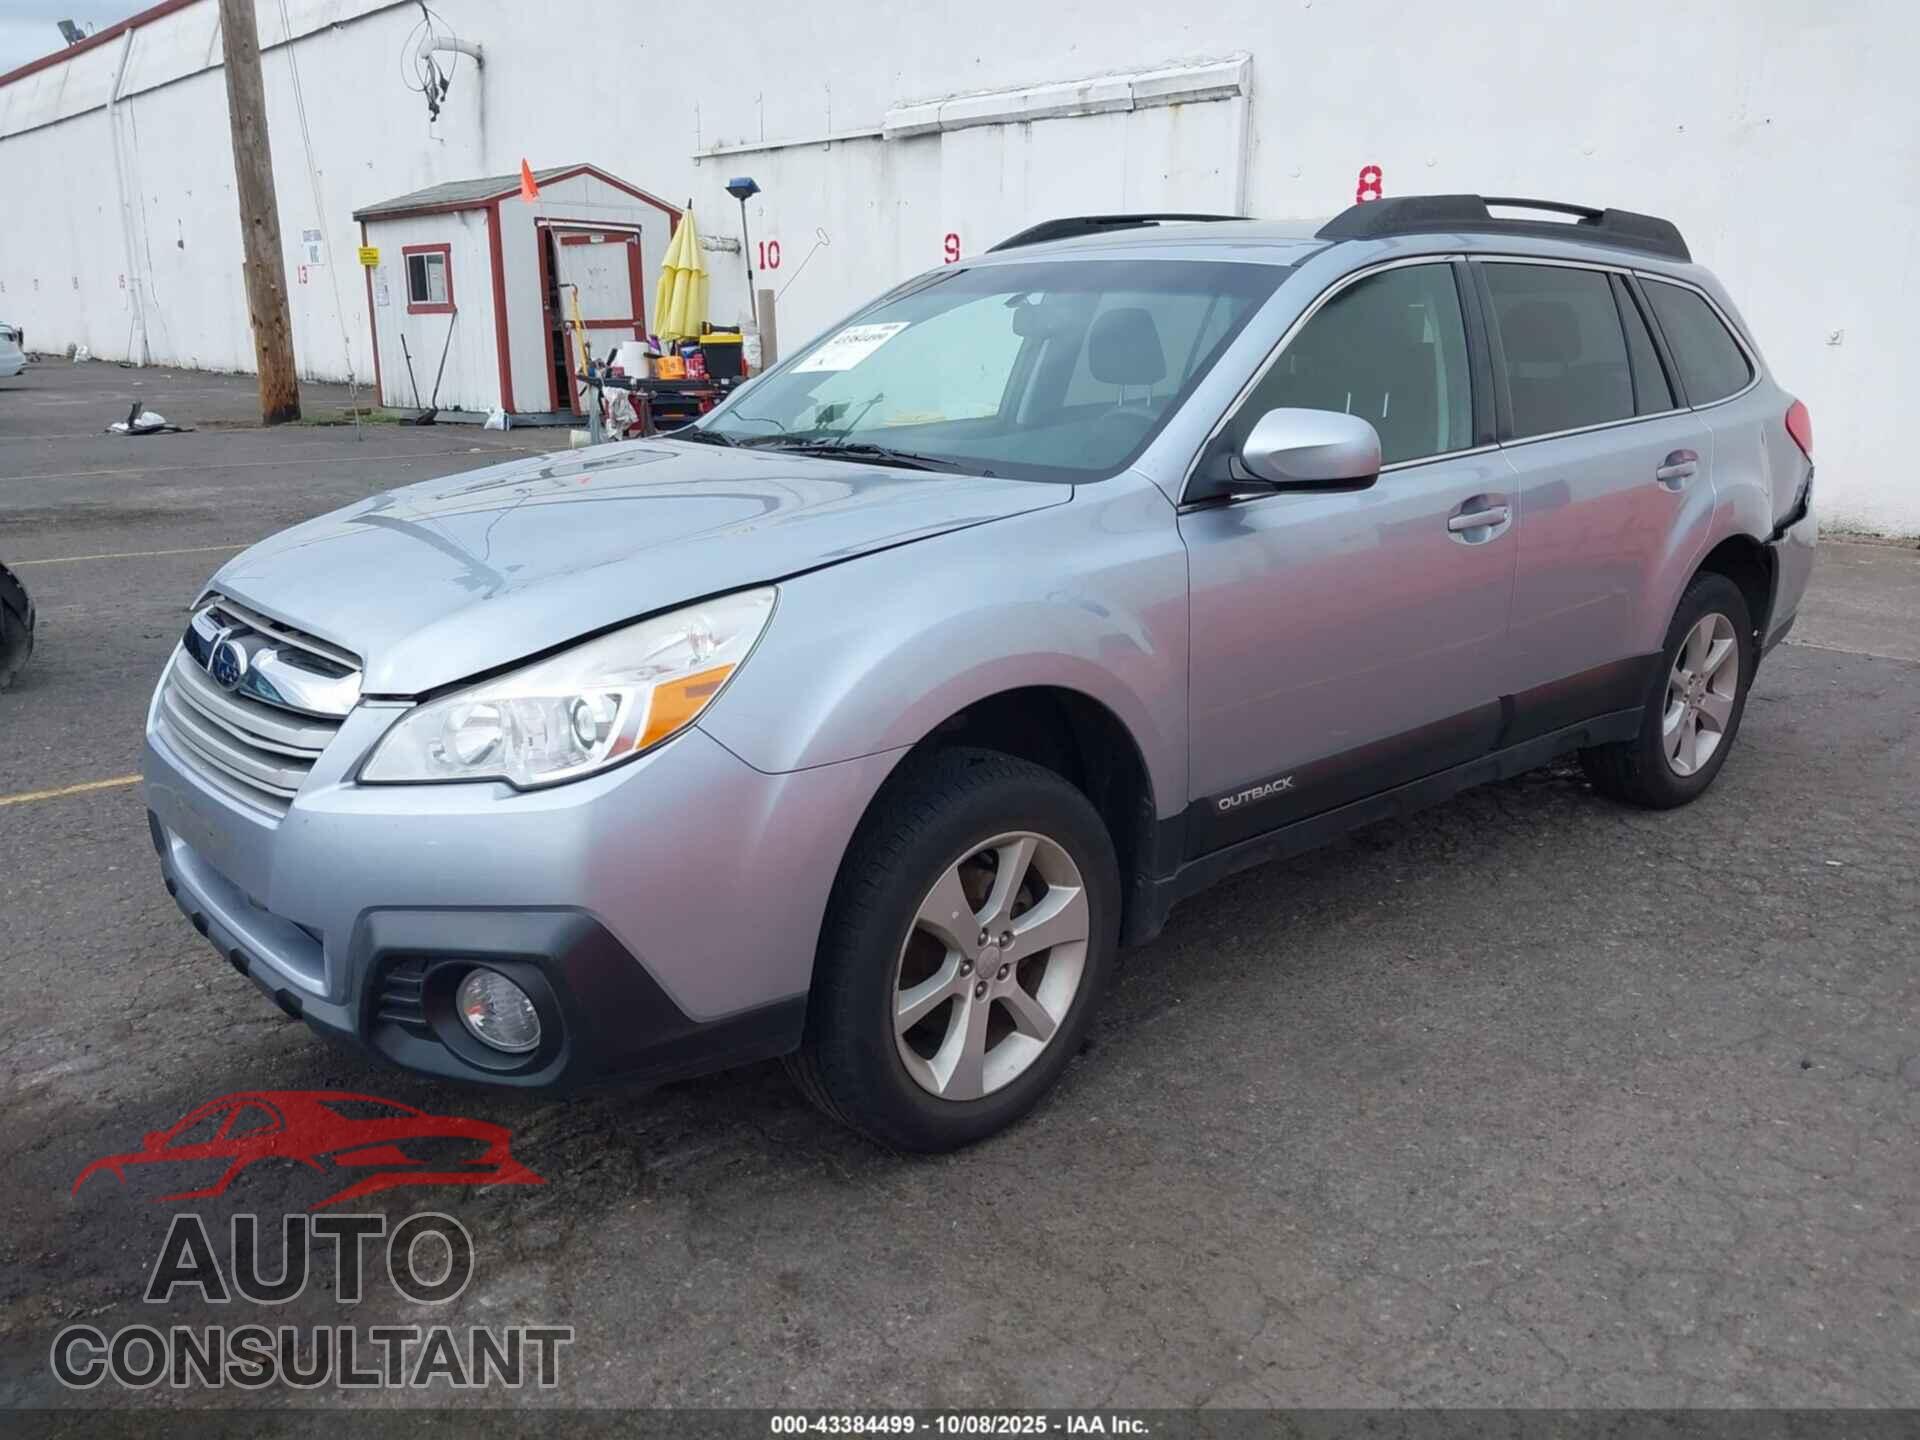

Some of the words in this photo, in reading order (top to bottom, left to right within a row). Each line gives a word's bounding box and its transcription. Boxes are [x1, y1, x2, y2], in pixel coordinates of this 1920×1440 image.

[1356, 164, 1382, 206] 8
[759, 240, 780, 270] 10
[944, 232, 960, 265] 9
[1218, 776, 1294, 810] OUTBACK
